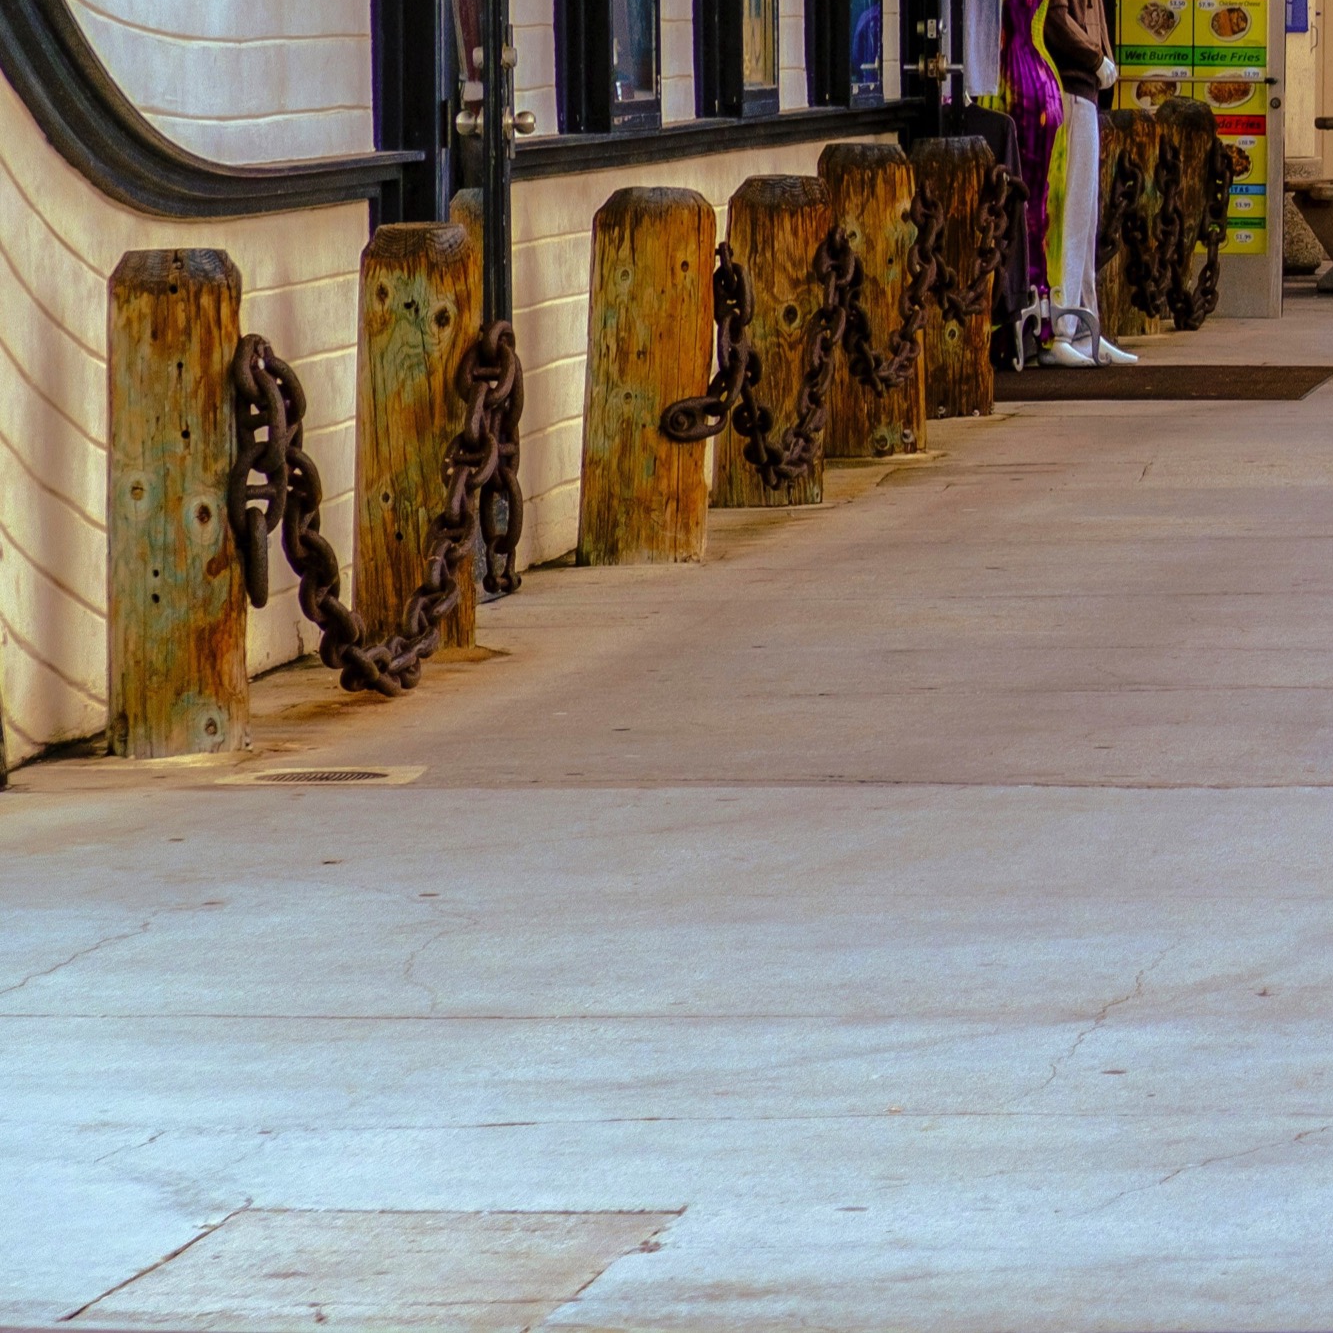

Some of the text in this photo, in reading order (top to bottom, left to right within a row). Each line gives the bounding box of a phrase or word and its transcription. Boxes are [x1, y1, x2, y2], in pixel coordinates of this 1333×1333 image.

[1124, 50, 1189, 61] Wet Burrito
[1199, 51, 1261, 62] Side Fries
[1234, 120, 1262, 130] Fries
